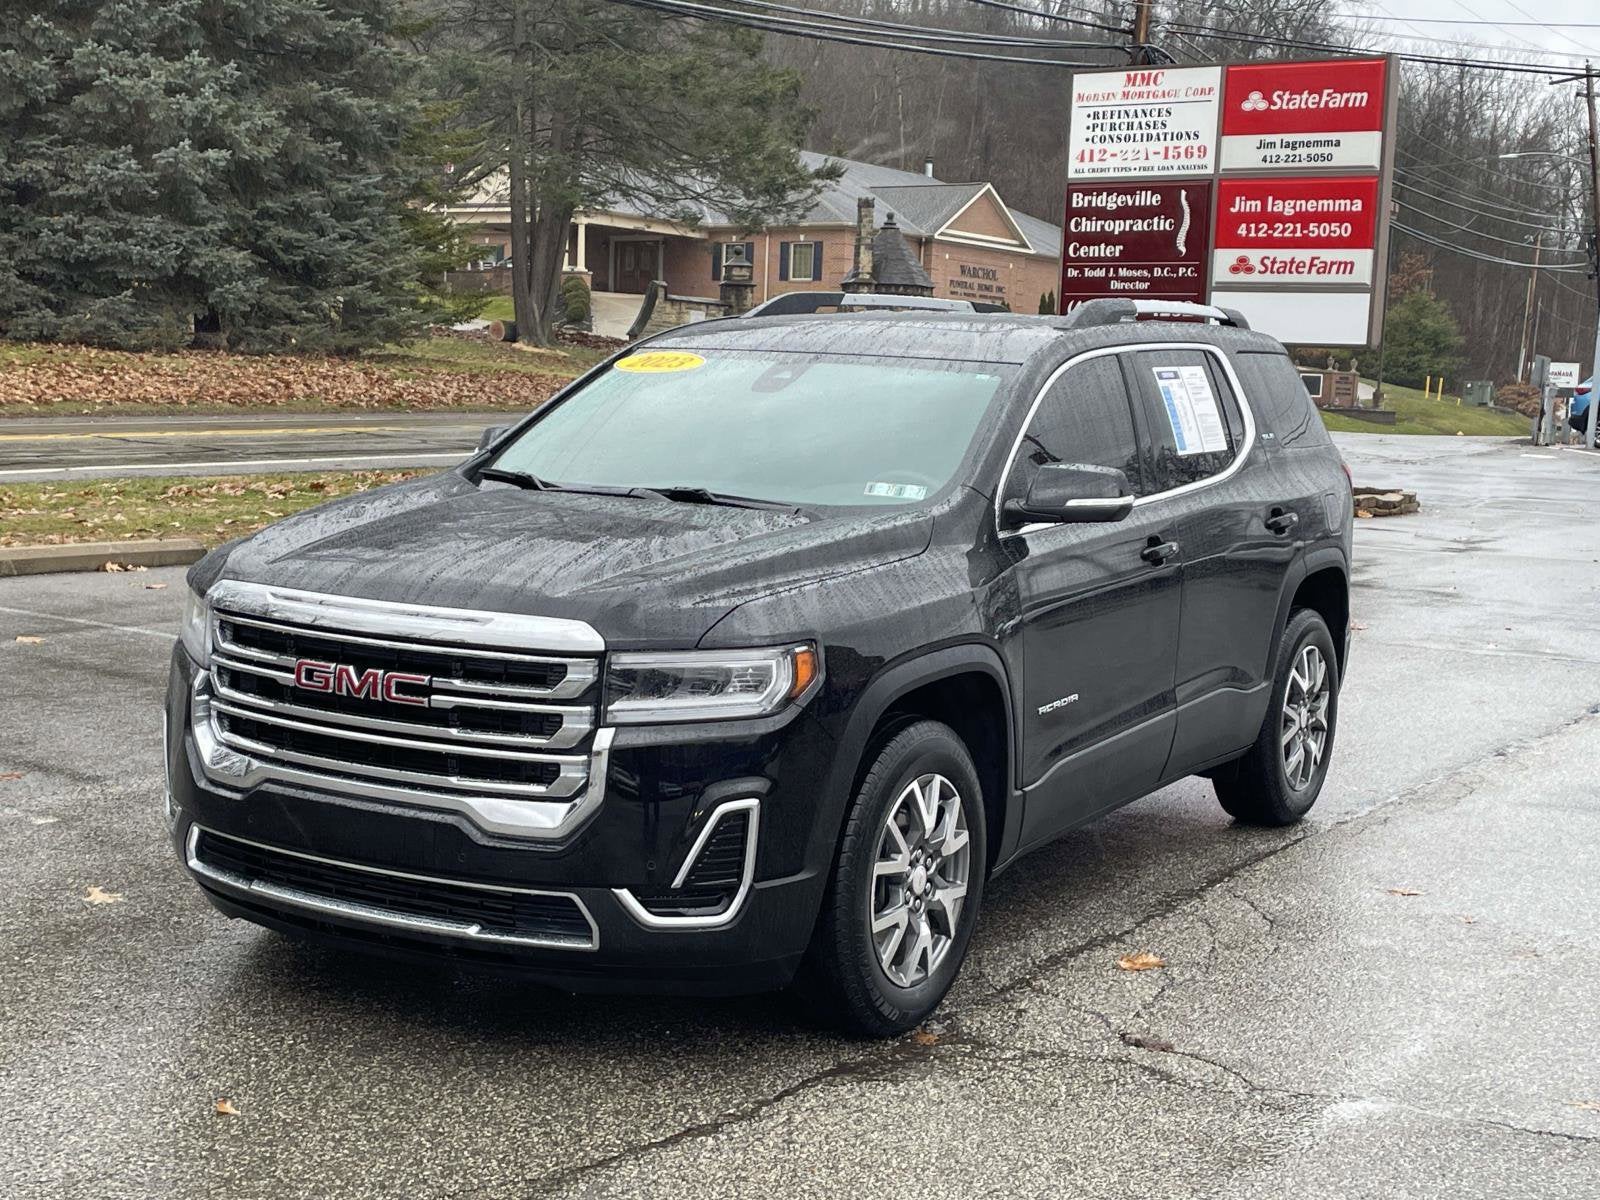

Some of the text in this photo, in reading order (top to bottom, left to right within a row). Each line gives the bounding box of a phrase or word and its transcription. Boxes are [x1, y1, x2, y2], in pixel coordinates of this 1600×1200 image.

[1124, 71, 1165, 88] MMC
[1120, 89, 1182, 101] MORTGAGE
[1092, 107, 1172, 120] REFINANCES
[1092, 120, 1167, 132] PURCHASES
[1091, 131, 1200, 144] CONSOLIDATIONS
[1256, 139, 1276, 150] Jim
[1076, 145, 1208, 163] 412-221-1569
[1261, 153, 1333, 164] 412-221-5050
[1071, 190, 1161, 210] Bridgeville
[1230, 196, 1261, 213] Jim
[1070, 215, 1175, 235] Chiropractic
[1237, 222, 1352, 238] 412-221-5050
[1068, 242, 1124, 258] Center
[960, 265, 998, 280] WARCHOL
[1067, 268, 1082, 278] Dr.
[1084, 267, 1106, 278] Todd
[1108, 267, 1116, 278] J.
[1118, 267, 1151, 279] Moses,
[1178, 267, 1198, 277] P.C.
[950, 280, 975, 290] FUNERAL
[978, 283, 993, 292] HOME
[1110, 280, 1151, 290] Director
[295, 658, 431, 708] GMC
[1038, 693, 1079, 715] ACADIA
